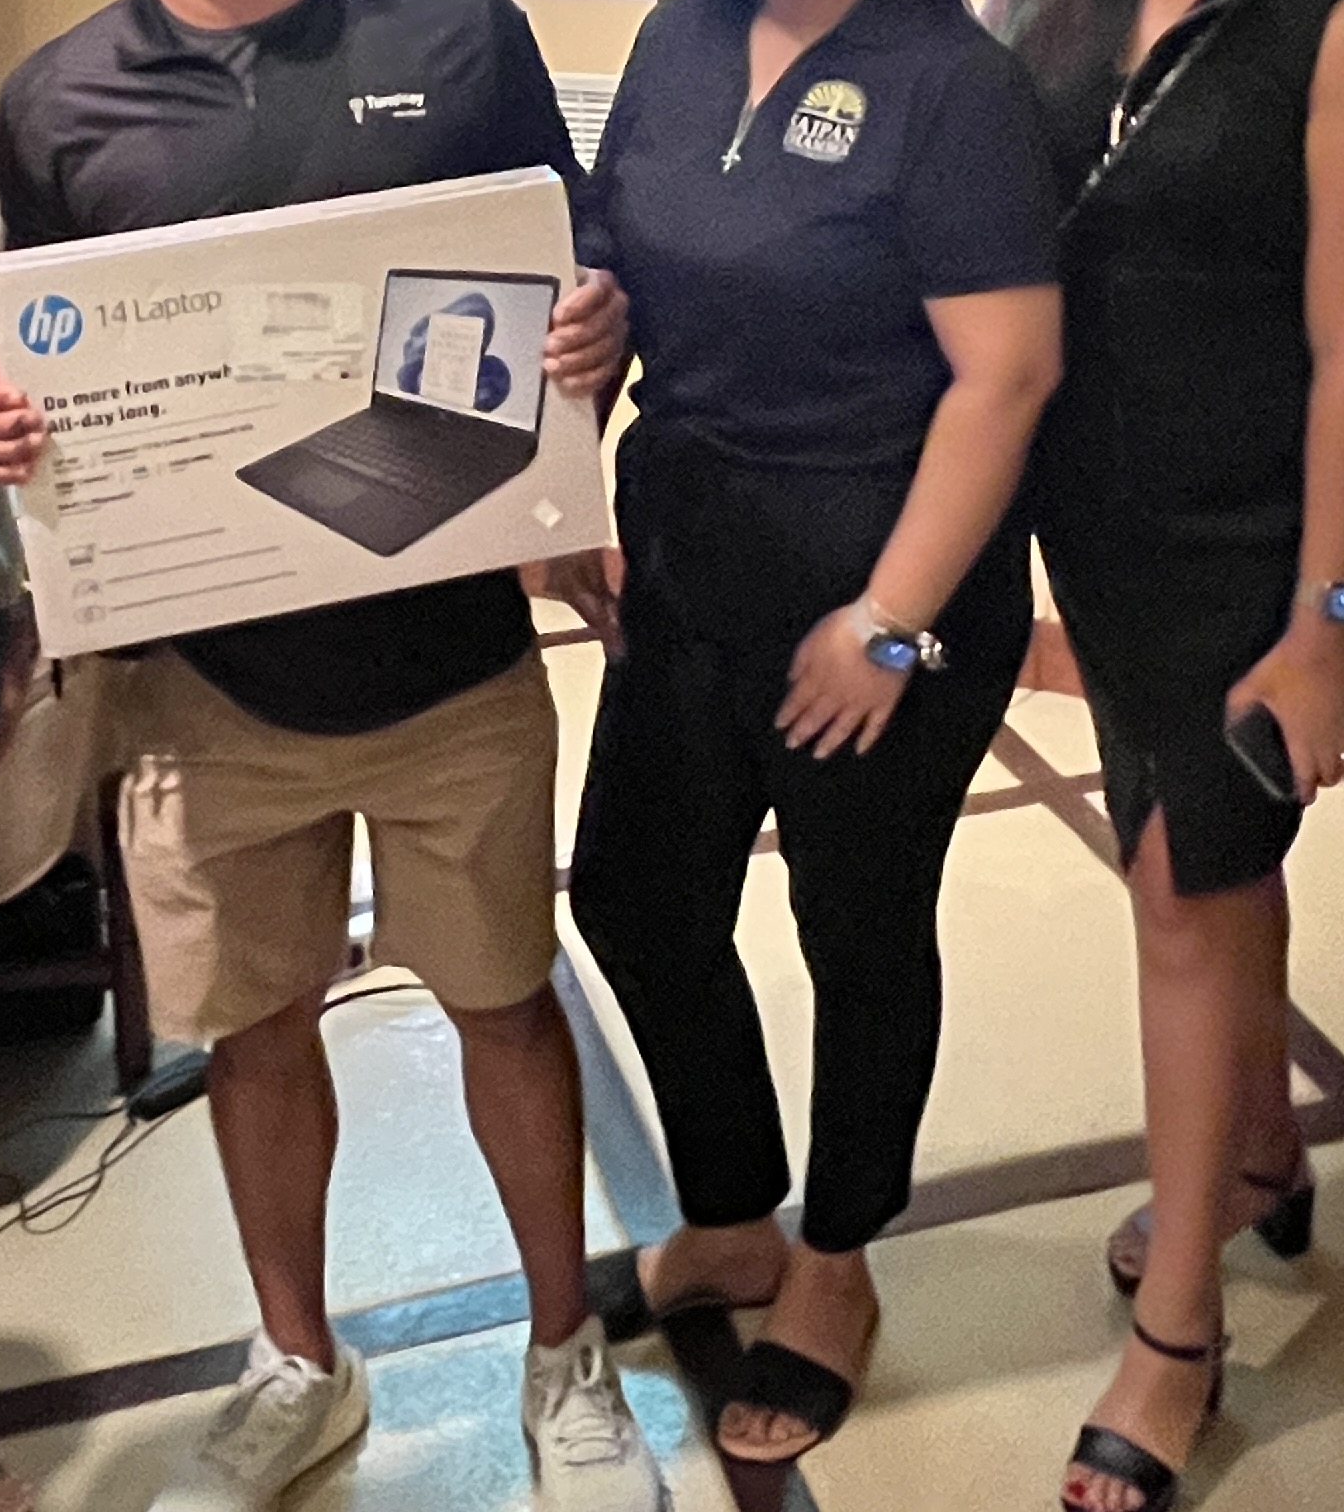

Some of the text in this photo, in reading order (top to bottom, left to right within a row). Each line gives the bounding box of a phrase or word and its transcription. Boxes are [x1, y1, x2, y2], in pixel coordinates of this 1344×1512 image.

[26, 295, 78, 356] hp
[95, 299, 128, 328] 14
[132, 290, 223, 324] Laptop
[43, 395, 68, 412] Do
[72, 387, 121, 407] more
[125, 380, 170, 397] from
